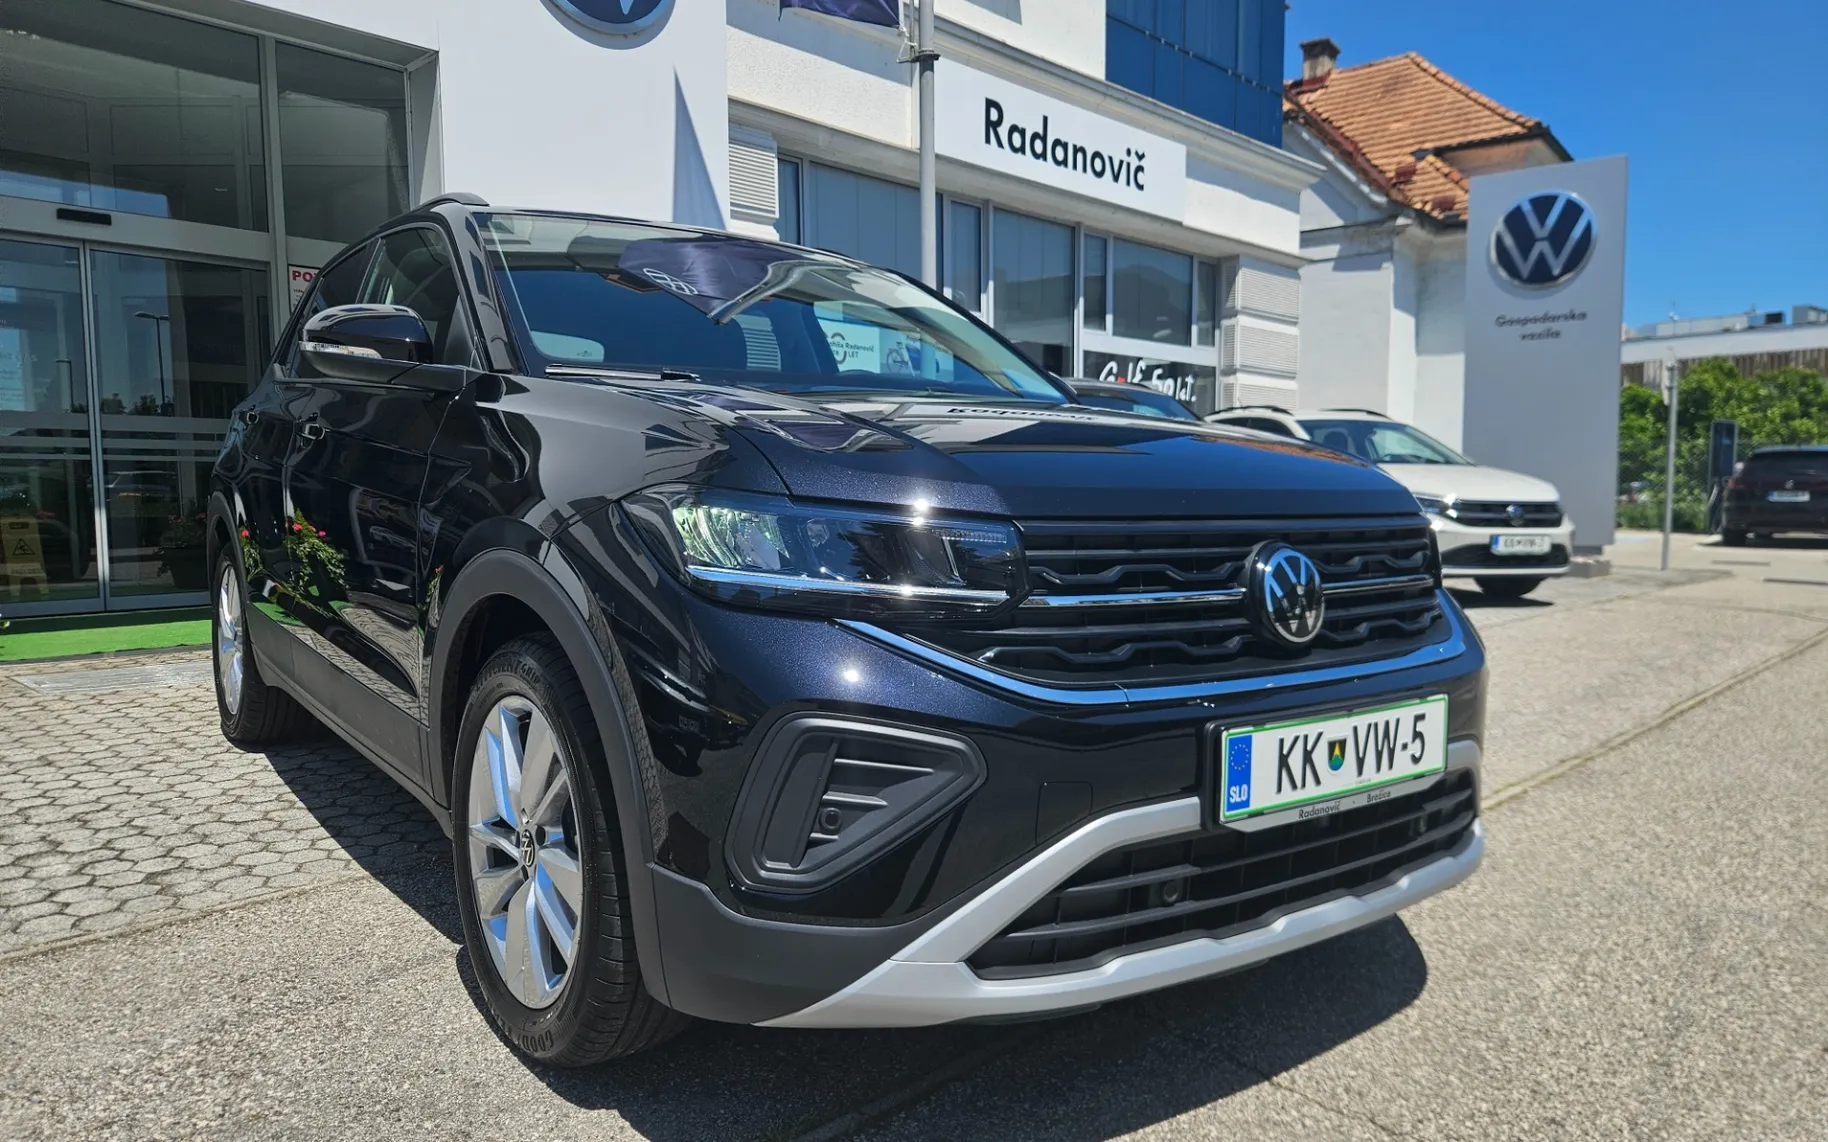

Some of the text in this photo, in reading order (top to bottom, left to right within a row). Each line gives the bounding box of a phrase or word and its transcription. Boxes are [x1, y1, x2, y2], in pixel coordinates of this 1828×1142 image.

[985, 97, 1145, 191] Radanovič
[1276, 713, 1426, 795] KK VW-5
[1229, 784, 1248, 803] SLO
[1298, 800, 1341, 820] Radanovič
